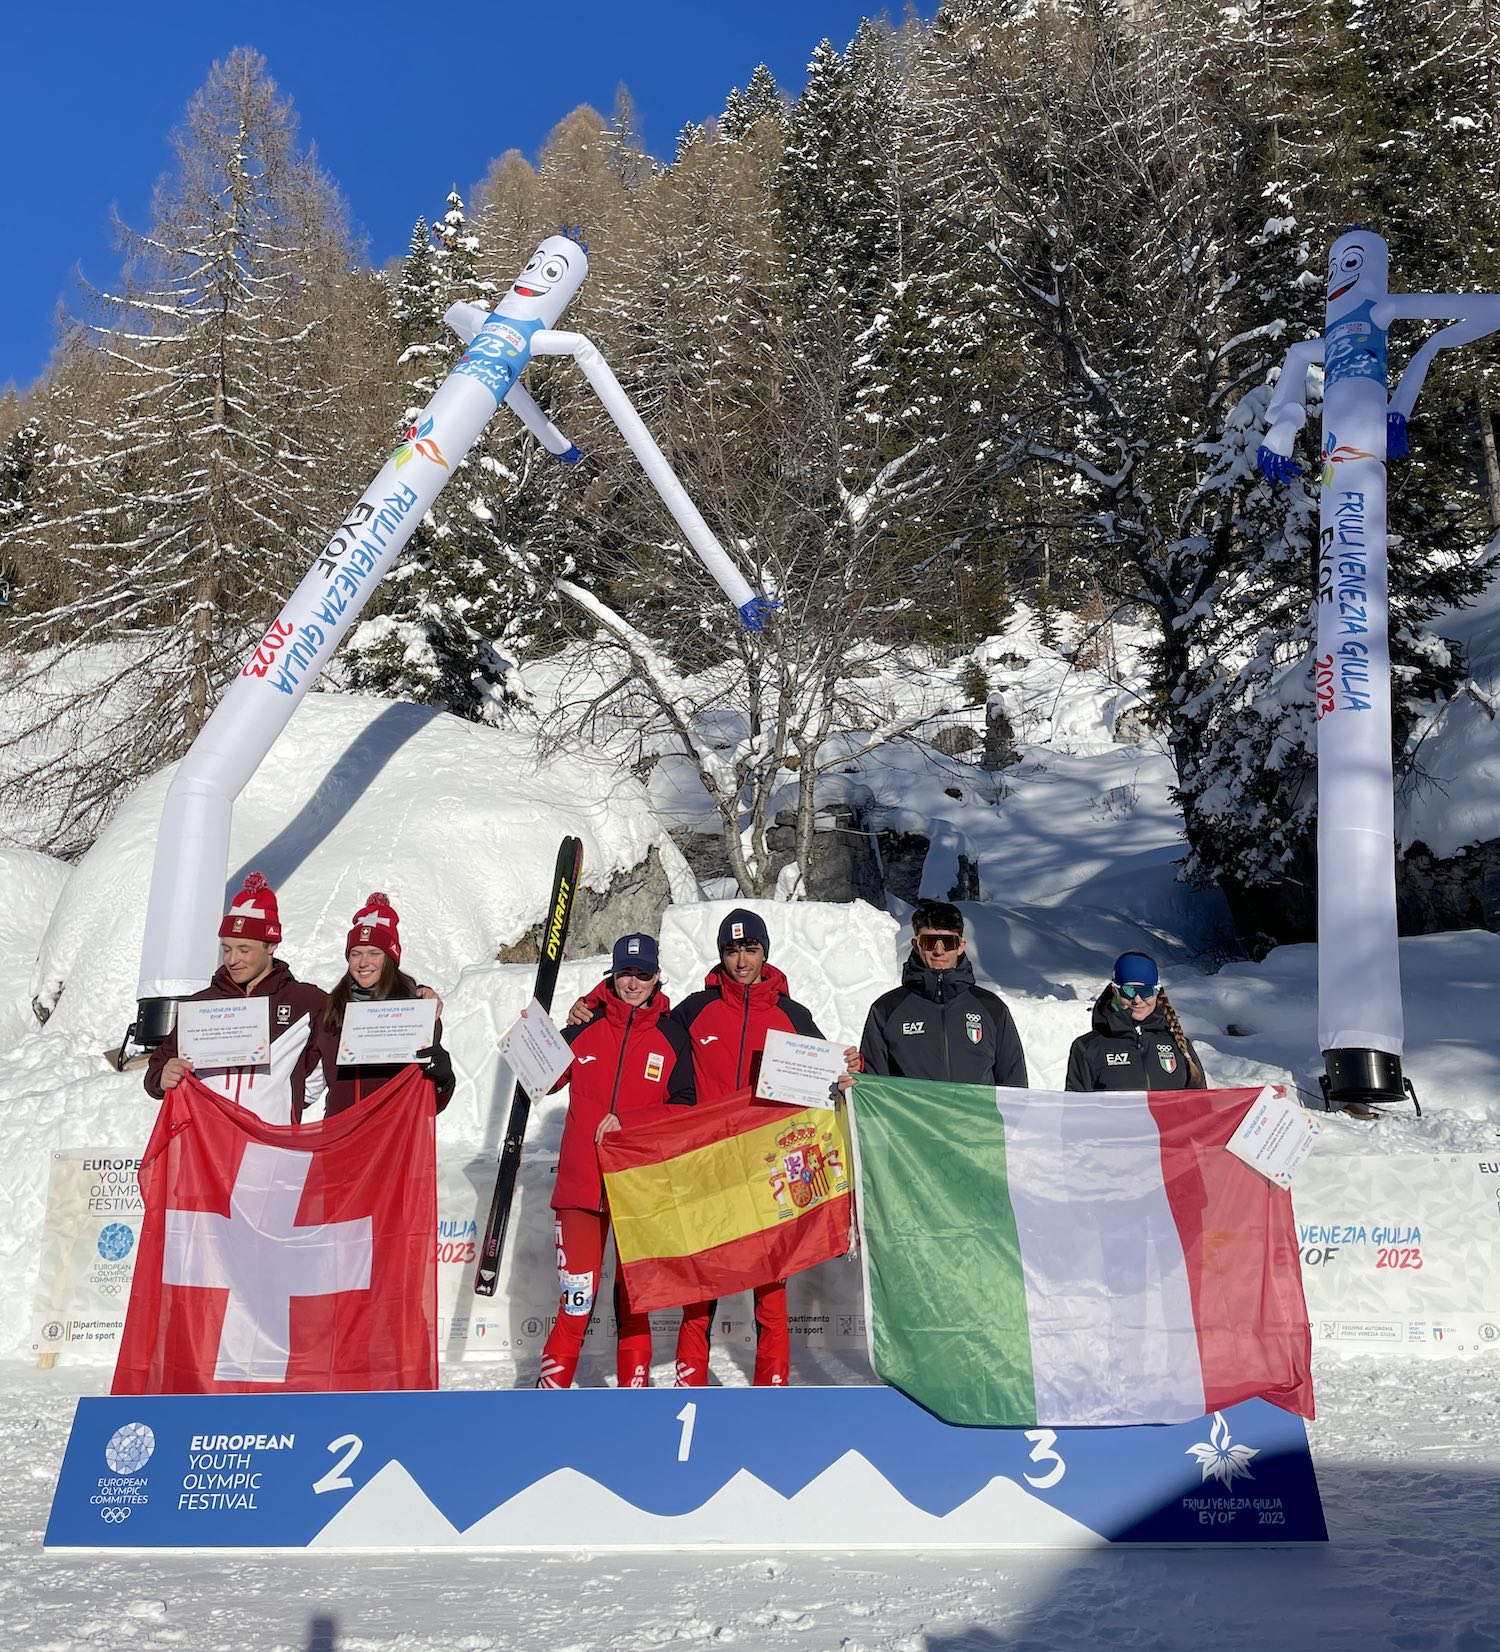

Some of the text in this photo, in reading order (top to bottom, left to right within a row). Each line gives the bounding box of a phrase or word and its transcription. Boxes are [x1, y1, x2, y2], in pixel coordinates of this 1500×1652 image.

[468, 336, 504, 358] 23
[242, 502, 374, 678] EYOF 2023
[267, 481, 418, 695] FRIULI VENEZIA GIULIA
[1334, 491, 1371, 712] FRIULI VENEZIA GIULIA
[1315, 526, 1335, 720] EYOF 2023
[547, 877, 570, 961] DYNAFIT
[902, 1022, 924, 1032] EA7
[1106, 1052, 1128, 1062] EA7
[82, 1160, 142, 1170] EUROPE
[98, 1172, 138, 1184] YOUT
[90, 1185, 140, 1197] OLYMP
[88, 1199, 143, 1210] FESTIVA
[437, 1221, 477, 1238] IULIA
[1300, 1225, 1422, 1246] VENEZIA GIULIA
[1376, 1248, 1423, 1270] 2023
[564, 1290, 584, 1306] 16
[72, 1320, 122, 1330] Dipartimento
[804, 1327, 823, 1335] sport
[72, 1334, 84, 1342] per
[95, 1333, 115, 1341] sport
[675, 1402, 696, 1462] 1
[190, 1434, 295, 1450] EUROPEAN
[189, 1454, 250, 1470] YOUTH
[312, 1434, 363, 1494] 2
[1023, 1429, 1066, 1488] 3
[98, 1478, 148, 1487] EUROPEAN
[183, 1473, 262, 1490] OLYMPIC
[102, 1487, 140, 1496] OLYMPIC
[90, 1496, 148, 1504] COMMITTEES
[178, 1494, 258, 1510] FESTIVAL
[1183, 1498, 1282, 1511] FRIULI VENEZIA GIULIA
[1199, 1511, 1286, 1525] EYOF 2023
